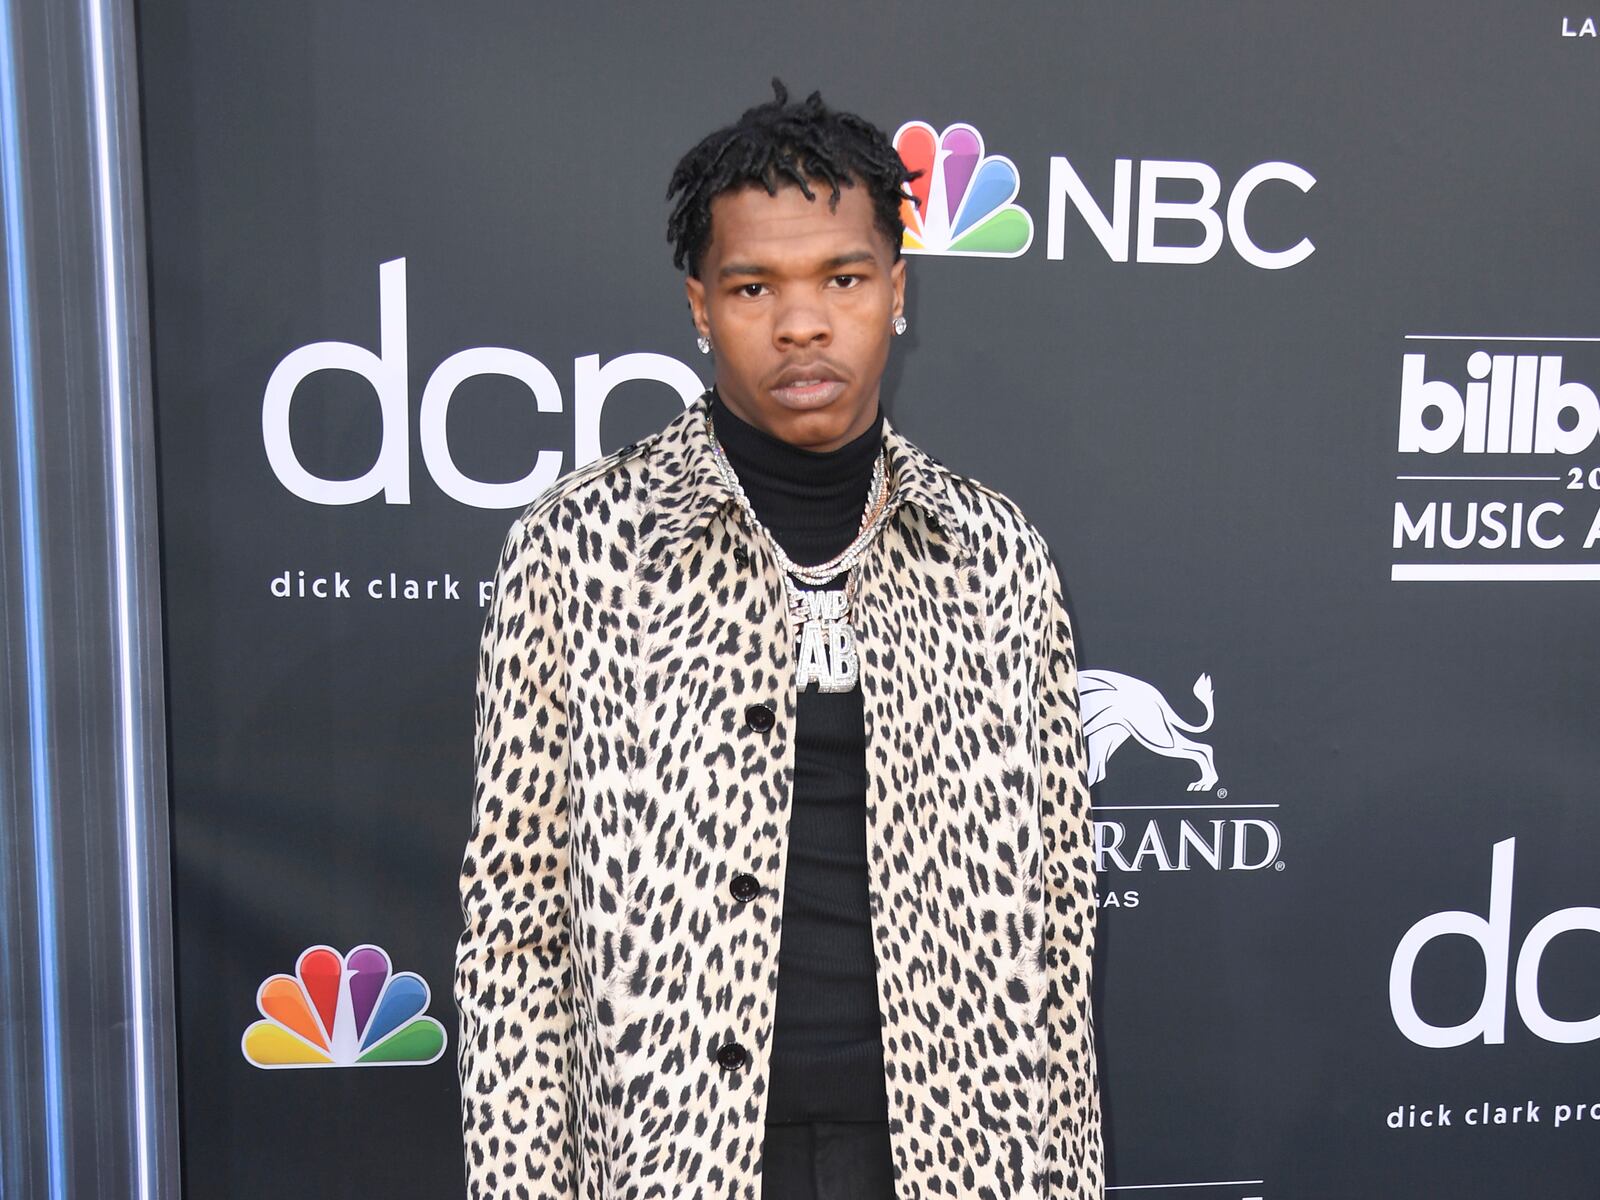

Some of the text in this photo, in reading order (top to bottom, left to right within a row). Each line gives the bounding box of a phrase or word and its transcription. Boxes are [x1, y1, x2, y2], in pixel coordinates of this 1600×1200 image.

[1562, 17, 1597, 37] LA
[1047, 156, 1317, 270] NBC
[1398, 351, 1600, 454] billb
[1393, 502, 1565, 550] MUSIC
[270, 570, 350, 598] dick
[368, 572, 460, 600] clark
[1093, 819, 1281, 872] RAND
[1096, 890, 1140, 908] AS
[1386, 1104, 1452, 1129] dick
[1464, 1100, 1540, 1126] clark
